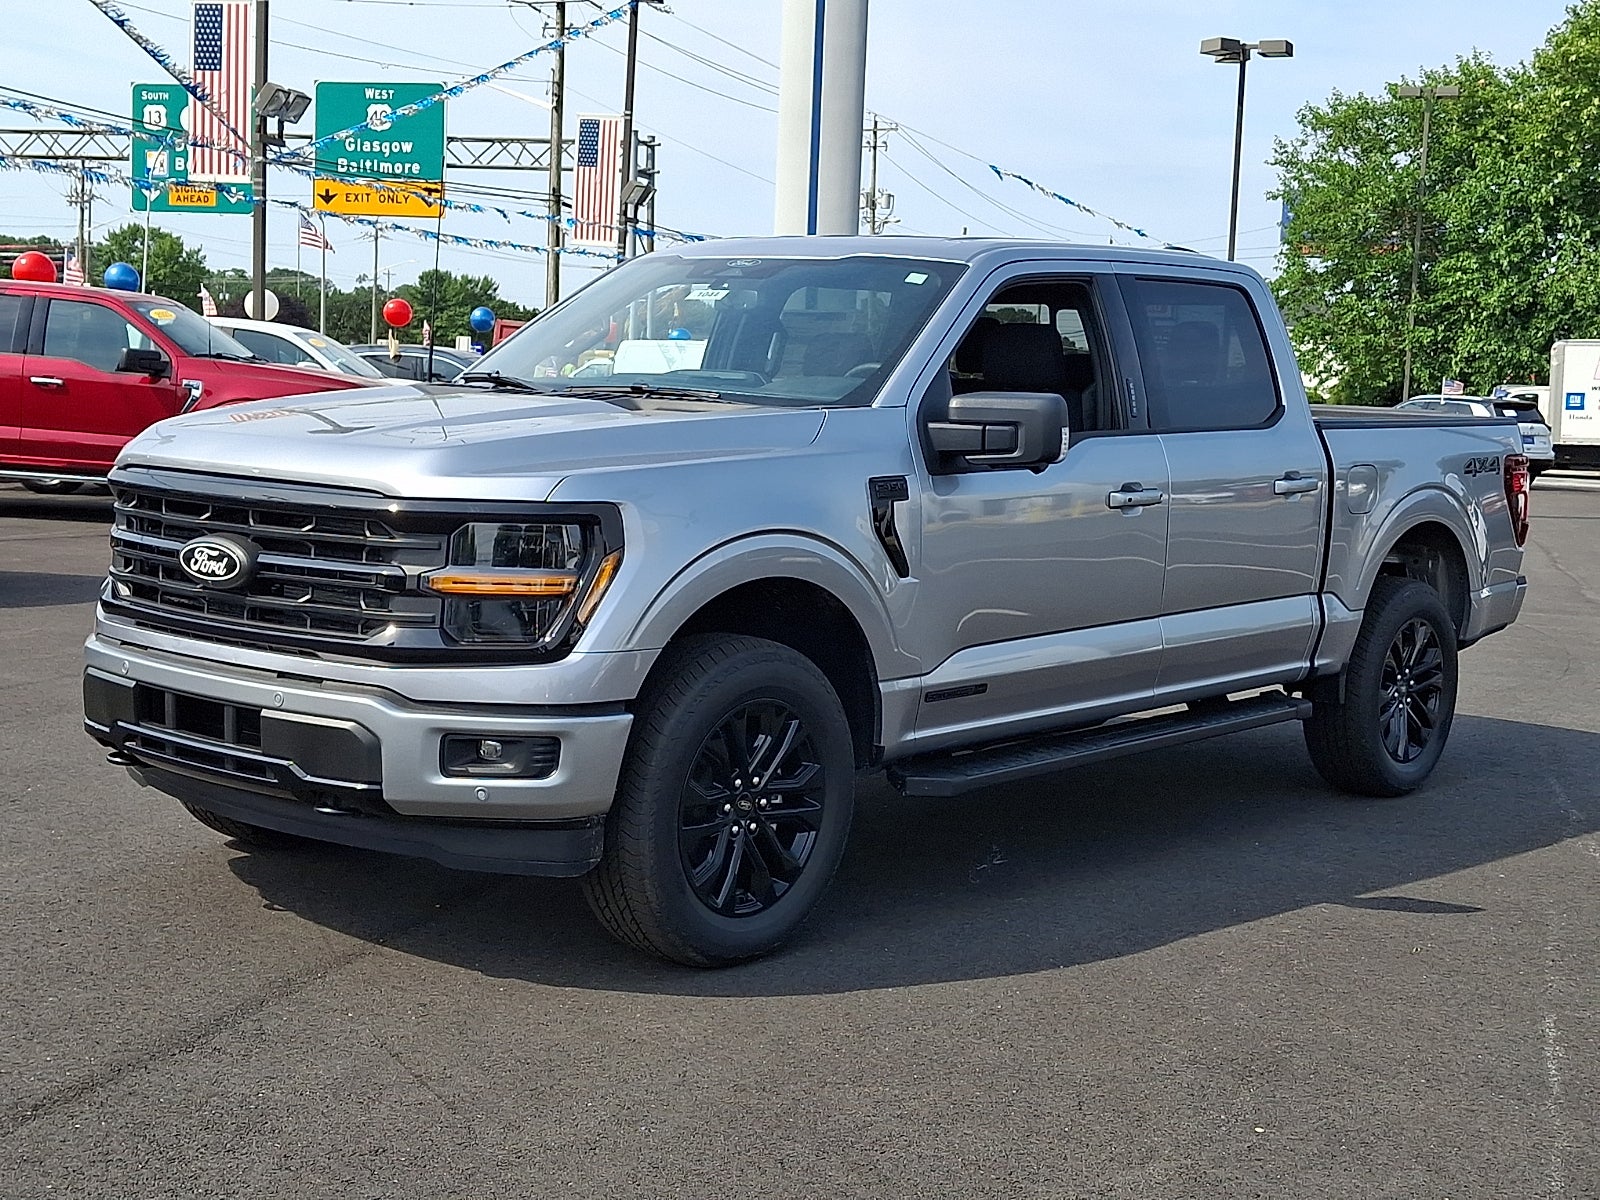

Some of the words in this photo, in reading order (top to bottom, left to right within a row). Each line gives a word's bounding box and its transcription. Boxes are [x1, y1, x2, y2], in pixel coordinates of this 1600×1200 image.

[149, 110, 162, 124] 13
[345, 137, 413, 158] Glasgow
[337, 158, 421, 174] Baltimore
[175, 195, 210, 204] AHEAD
[345, 192, 371, 203] EXIT
[378, 193, 410, 204] ONLY
[190, 546, 229, 576] Ford
